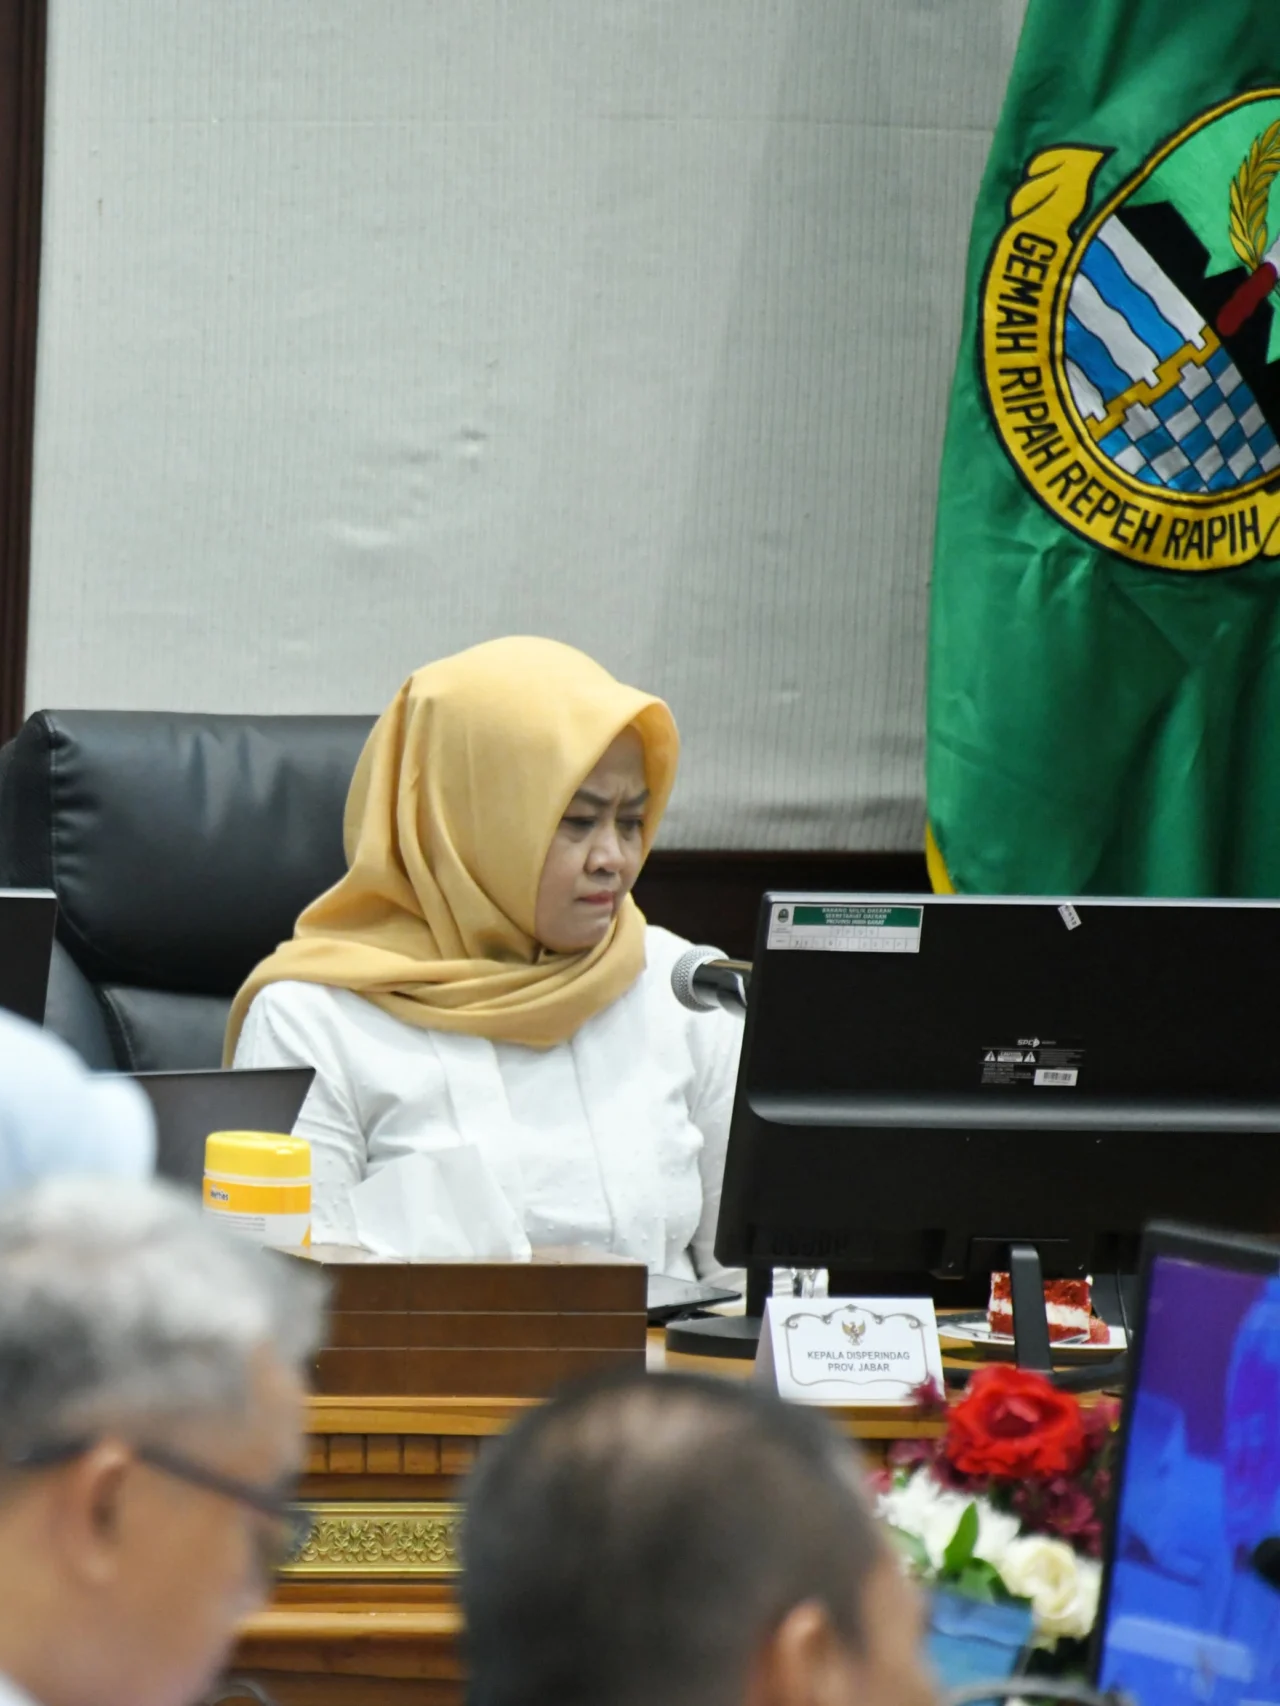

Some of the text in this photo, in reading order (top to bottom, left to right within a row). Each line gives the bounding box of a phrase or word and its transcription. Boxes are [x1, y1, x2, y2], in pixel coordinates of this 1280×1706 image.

[995, 231, 1261, 560] GEMAH RIPAH REPEH RAPIH
[807, 1351, 911, 1361] KEPALA DISPERINDAG
[827, 1362, 891, 1373] PROV. JABAR
